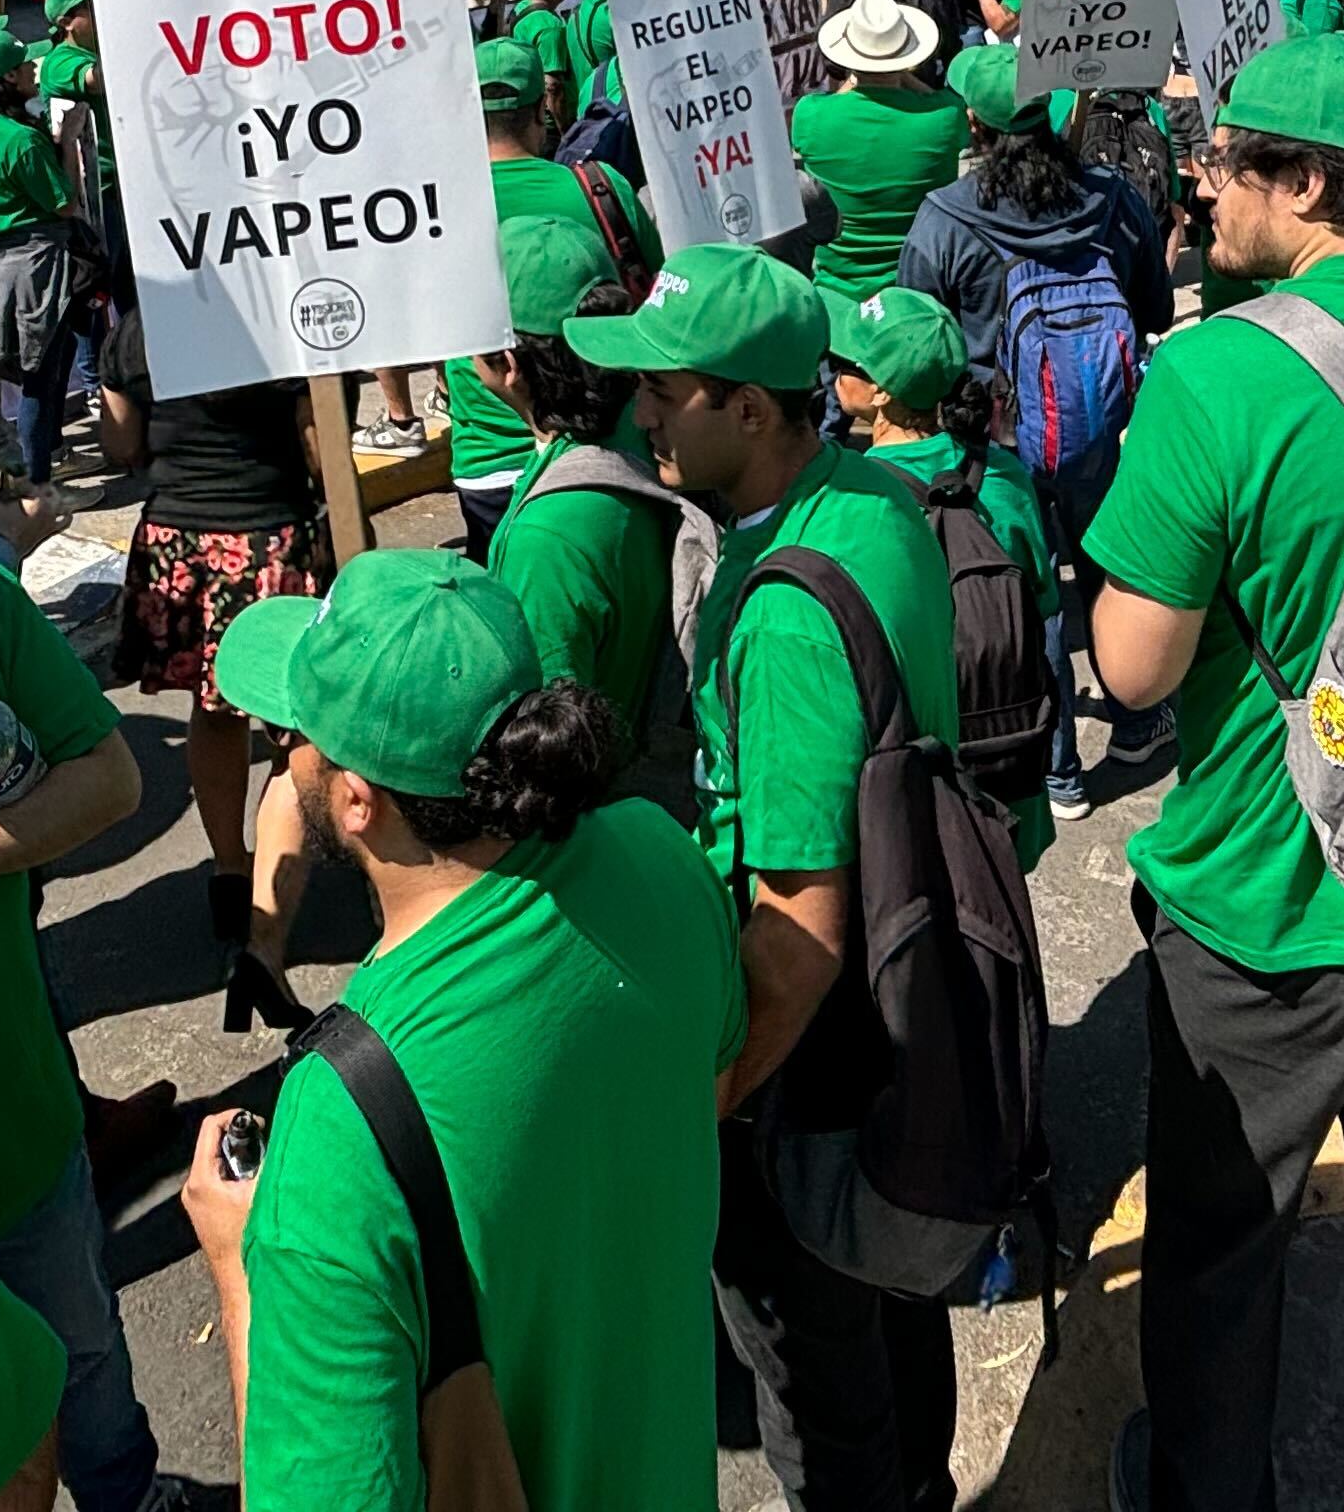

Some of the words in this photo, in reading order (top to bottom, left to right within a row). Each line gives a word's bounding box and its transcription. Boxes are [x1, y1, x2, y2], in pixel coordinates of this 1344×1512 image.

[1068, 1, 1127, 27] ¡YO
[686, 50, 719, 81] EL
[1031, 30, 1152, 59] VAPEO!
[665, 85, 753, 132] VAPEO
[237, 98, 363, 178] ¡YO
[694, 131, 753, 189] ¡YA!
[160, 183, 443, 271] VAPEO!
